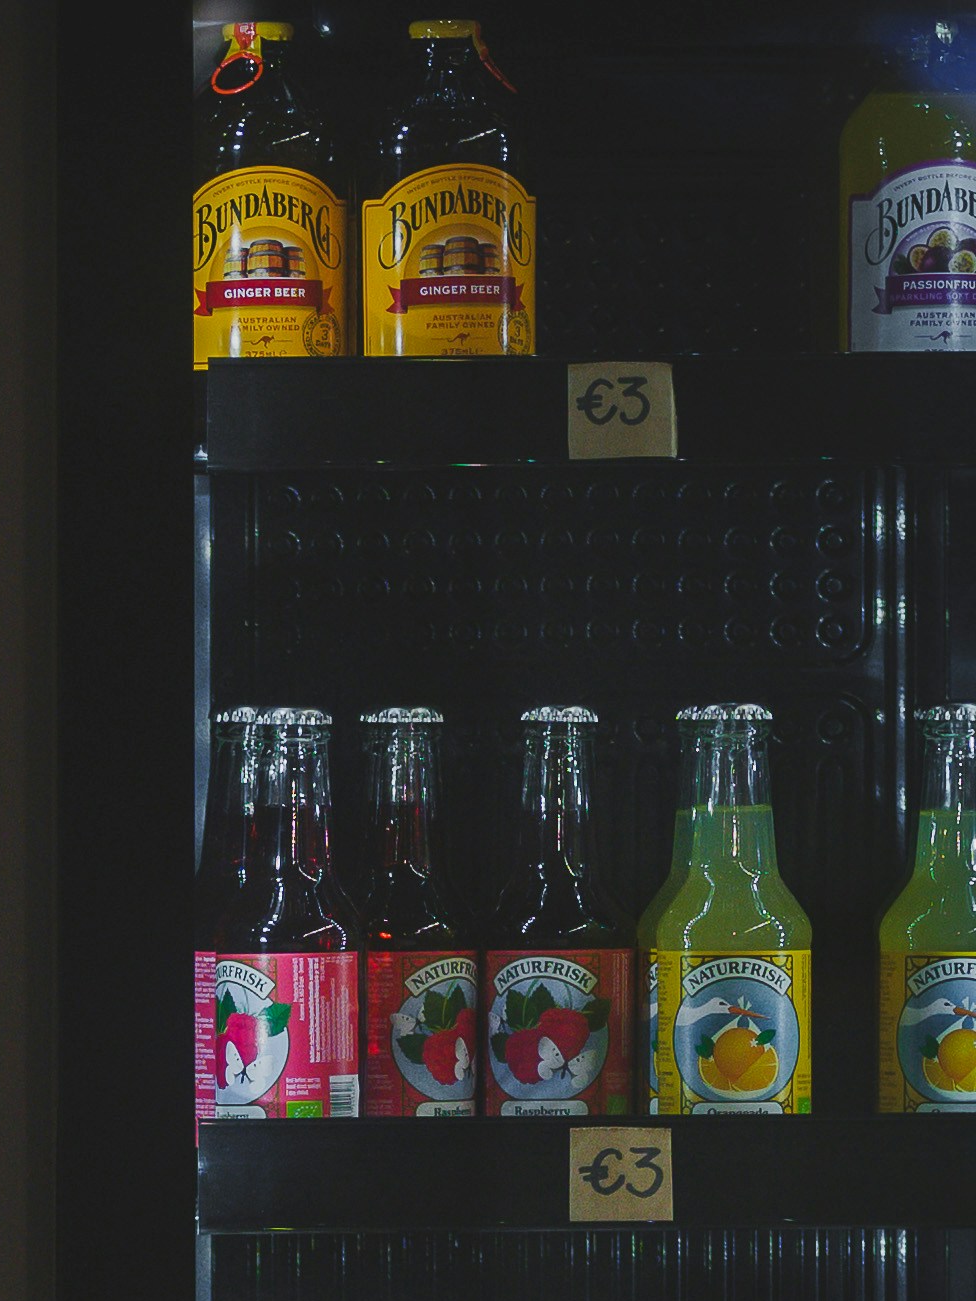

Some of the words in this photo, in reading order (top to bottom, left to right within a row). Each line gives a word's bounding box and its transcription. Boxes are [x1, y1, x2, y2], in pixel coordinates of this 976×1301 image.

[193, 184, 342, 273] BUNDABERG
[378, 182, 531, 271] BUNDABERG
[224, 287, 271, 299] GINGER
[274, 287, 306, 298] BEER
[420, 285, 467, 296] GINGER
[470, 285, 500, 295] BEER
[237, 316, 297, 325] AUSTRALIAN
[266, 324, 300, 332] OWNED
[433, 313, 492, 322] AUSTRALIAN
[576, 376, 651, 426] €3
[499, 959, 591, 990] NATURFRISK
[687, 961, 785, 990] NATURFRISK
[578, 1147, 664, 1198] €3
